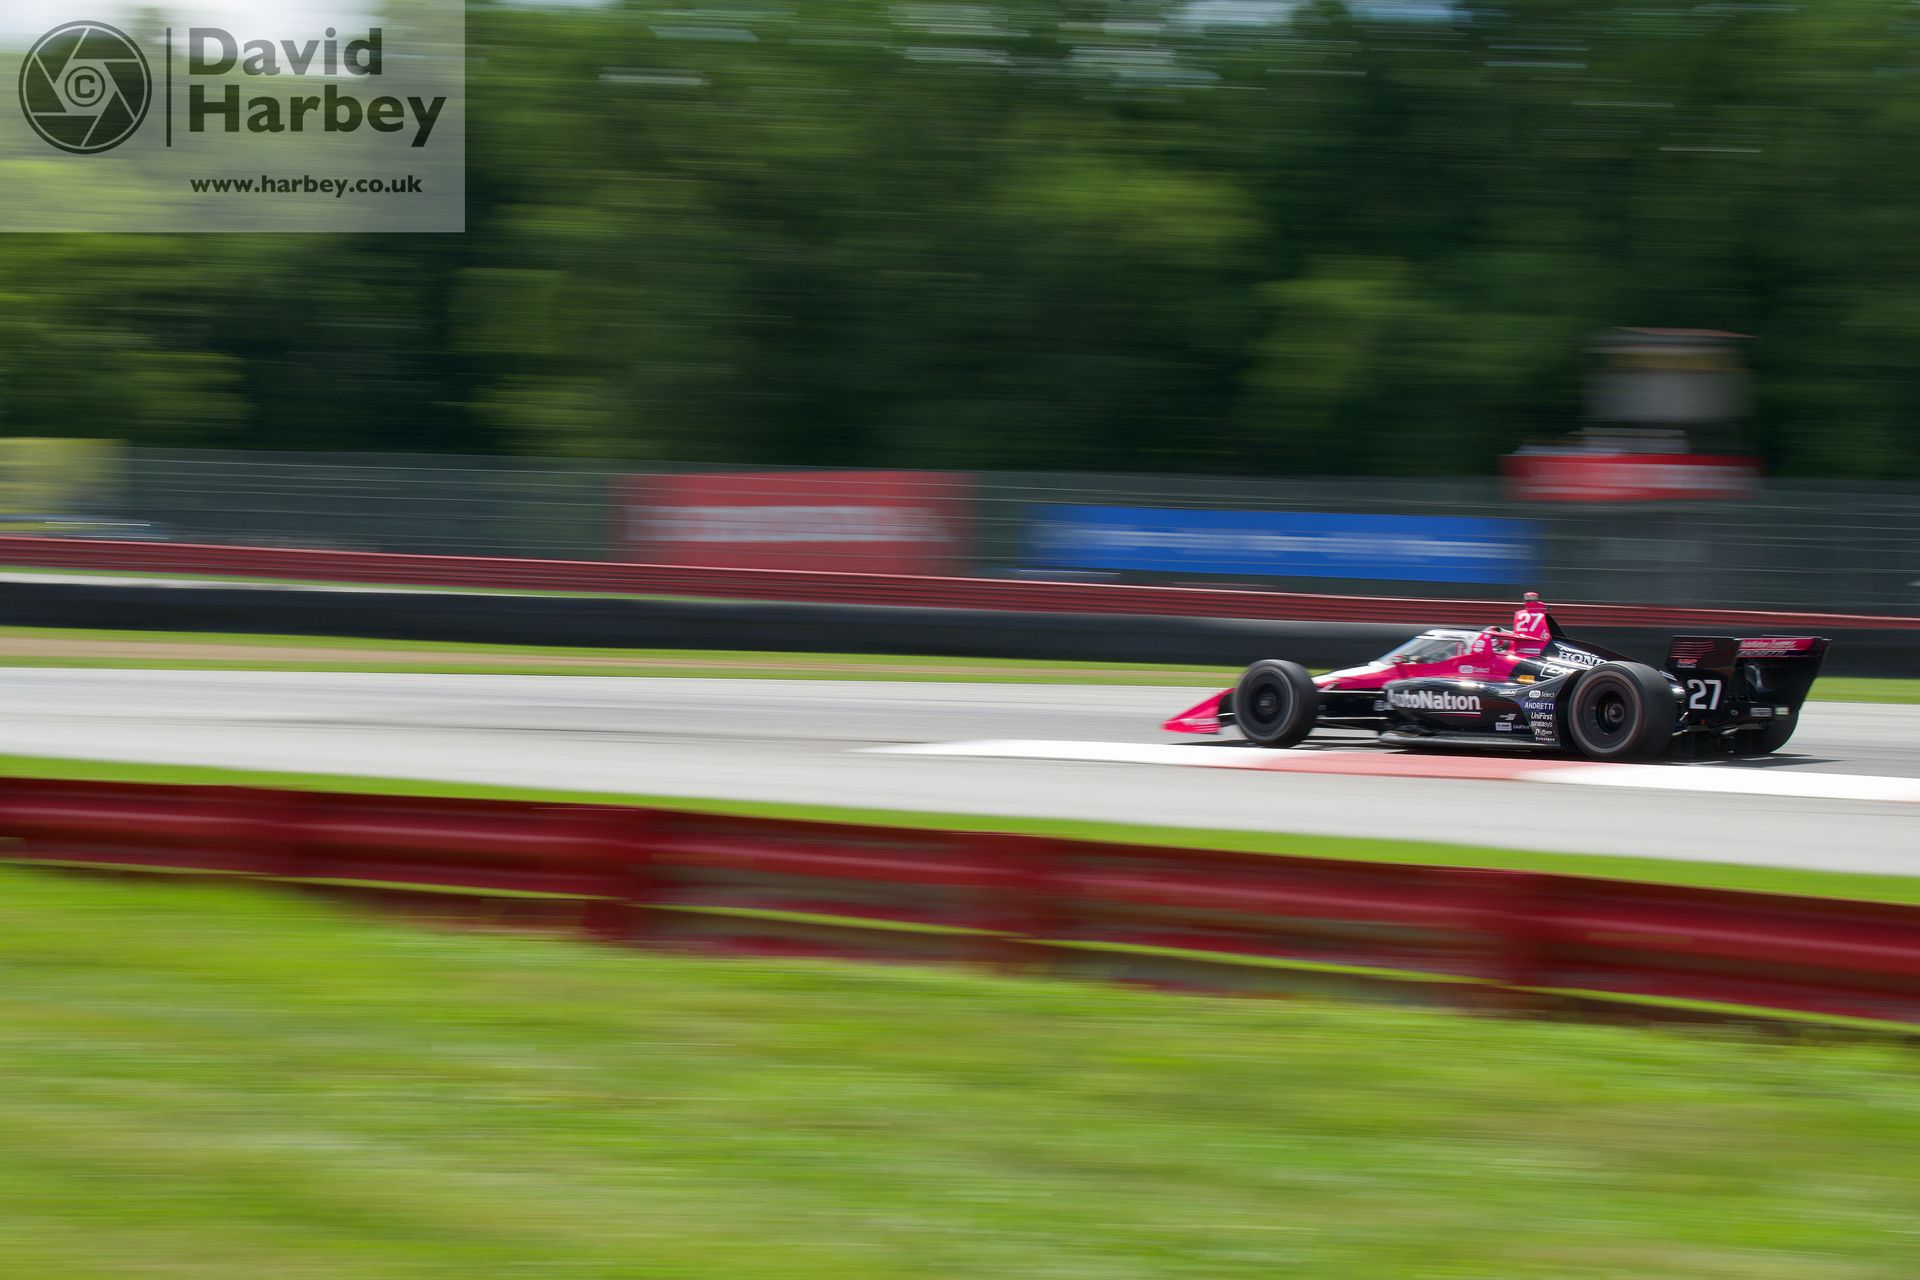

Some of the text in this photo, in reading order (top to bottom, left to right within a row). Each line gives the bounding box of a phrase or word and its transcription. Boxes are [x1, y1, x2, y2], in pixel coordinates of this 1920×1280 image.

[1515, 612, 1545, 632] 27
[1387, 689, 1482, 710] AutoNation
[1687, 679, 1722, 710] 27
[1524, 702, 1554, 710] ANDRETTI
[1531, 712, 1553, 720] UniFirst
